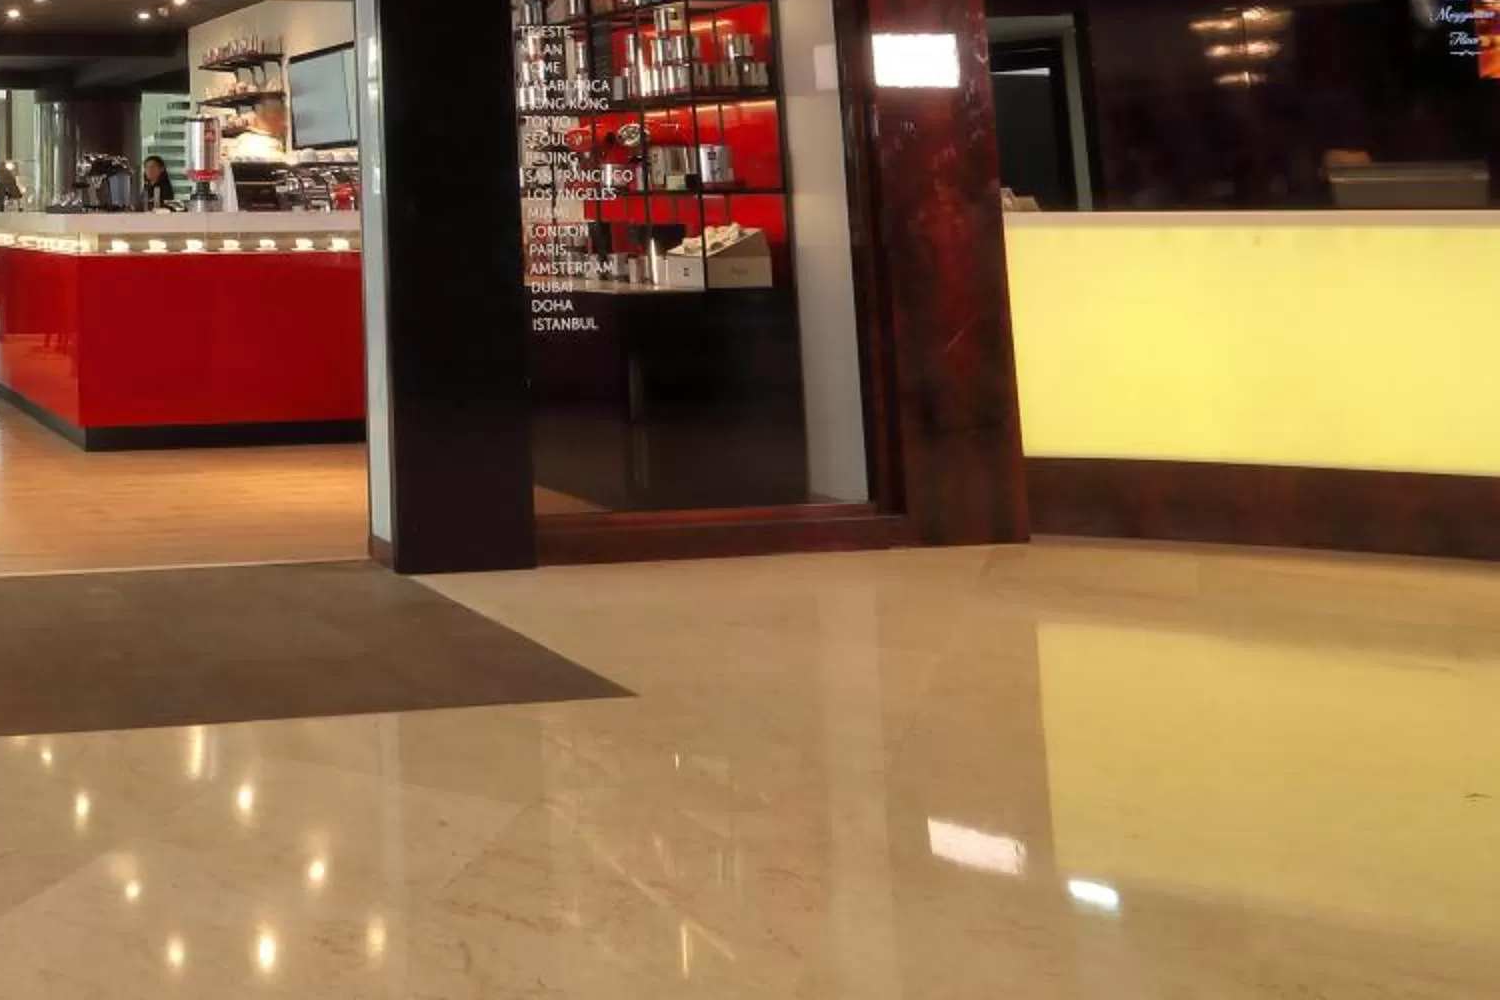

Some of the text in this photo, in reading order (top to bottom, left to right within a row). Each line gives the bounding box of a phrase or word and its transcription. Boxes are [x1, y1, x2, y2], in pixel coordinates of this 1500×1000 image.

[520, 43, 563, 56] MAN
[521, 61, 561, 74] OME
[521, 79, 611, 93] ASABLANCA
[568, 97, 609, 110] KONG
[523, 116, 572, 128] TOKYO
[524, 132, 569, 146] SEOUL
[525, 169, 633, 183] SAN FRANCICO
[527, 187, 618, 201] LOS ANGELES
[528, 224, 589, 238] LONDON
[529, 243, 568, 257] PARIS
[530, 261, 614, 276] AMSTERDAM
[531, 280, 573, 294] DUBAI
[531, 299, 574, 313] DOHA
[532, 317, 598, 331] ISTANBUL
